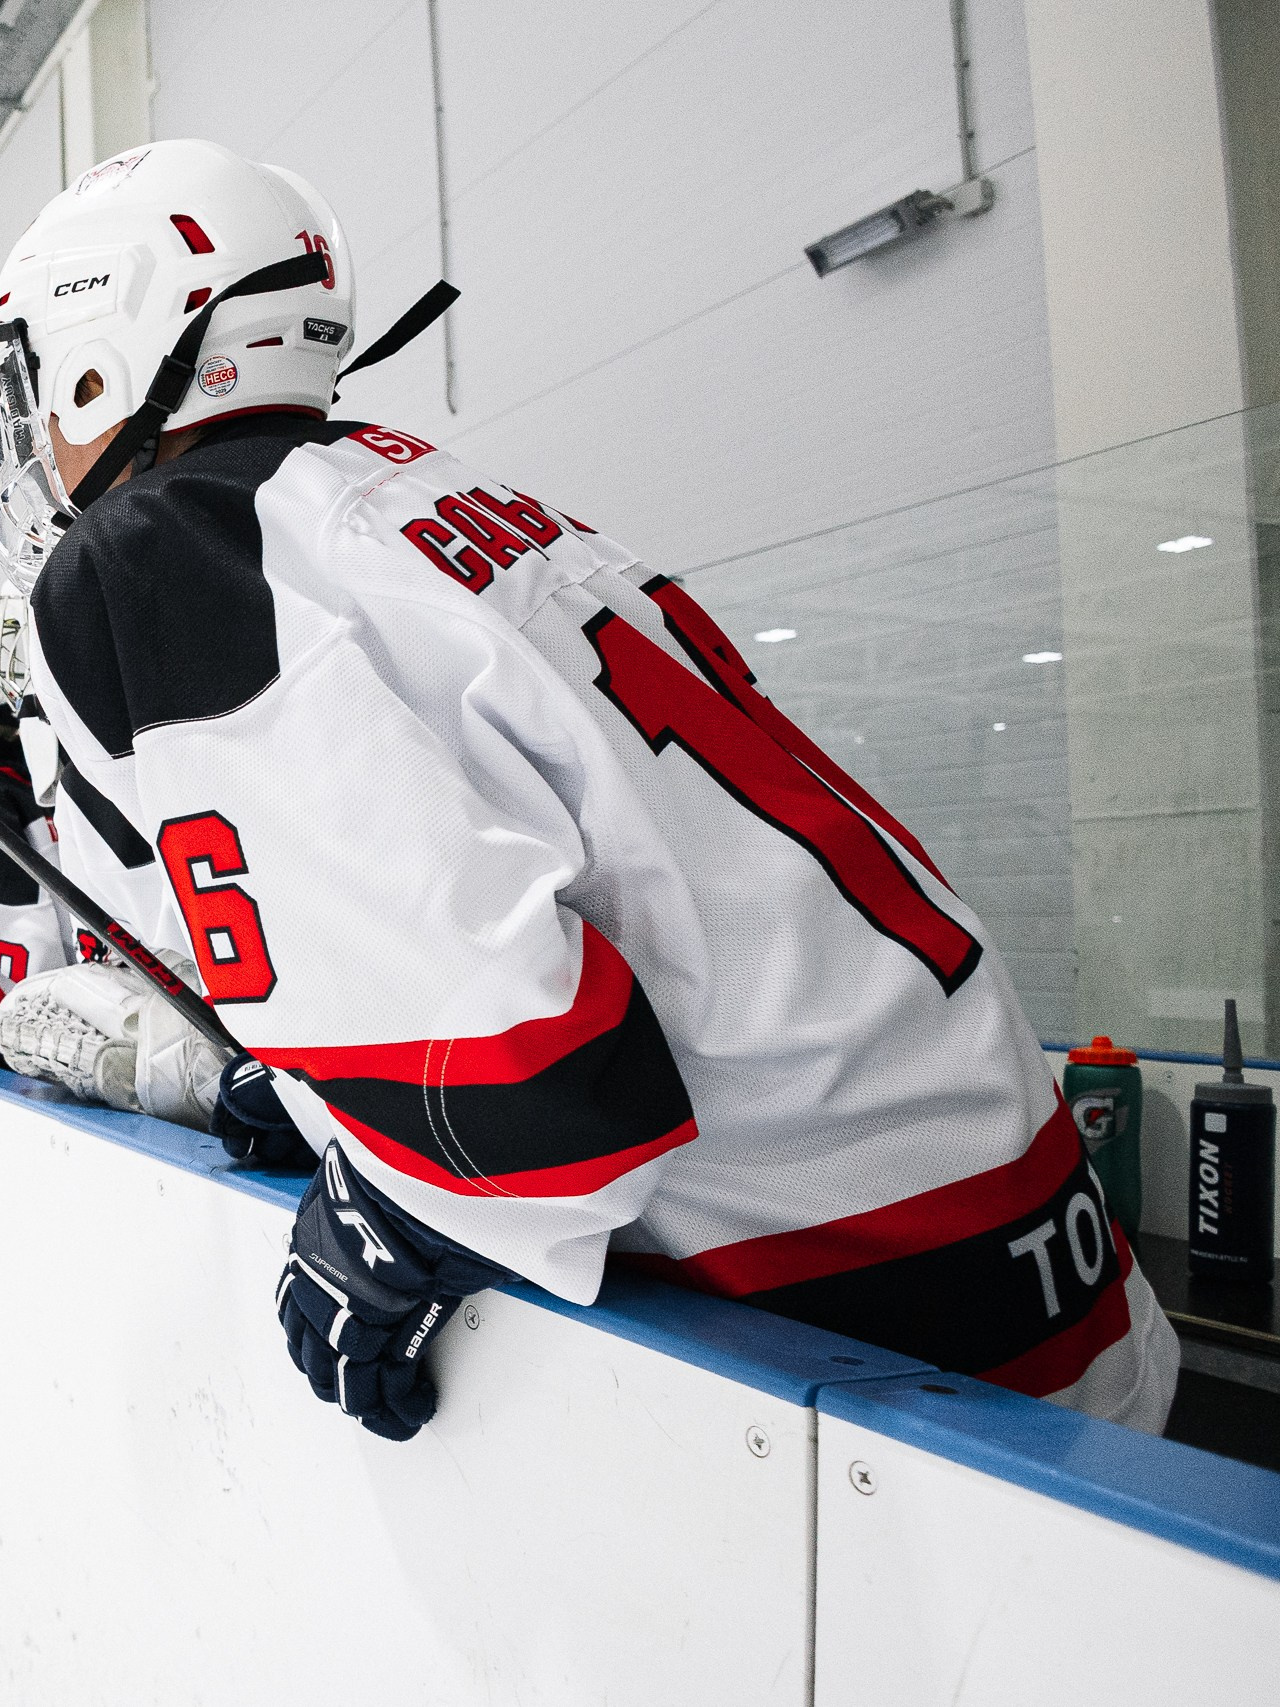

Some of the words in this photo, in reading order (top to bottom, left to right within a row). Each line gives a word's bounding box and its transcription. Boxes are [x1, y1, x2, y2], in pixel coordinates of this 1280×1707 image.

[54, 274, 110, 297] CCM
[307, 321, 336, 335] TACKS
[206, 368, 235, 385] HECC
[1199, 1138, 1219, 1235] TIXON
[308, 1253, 349, 1282] SUPREME
[405, 1302, 442, 1359] BAUER
